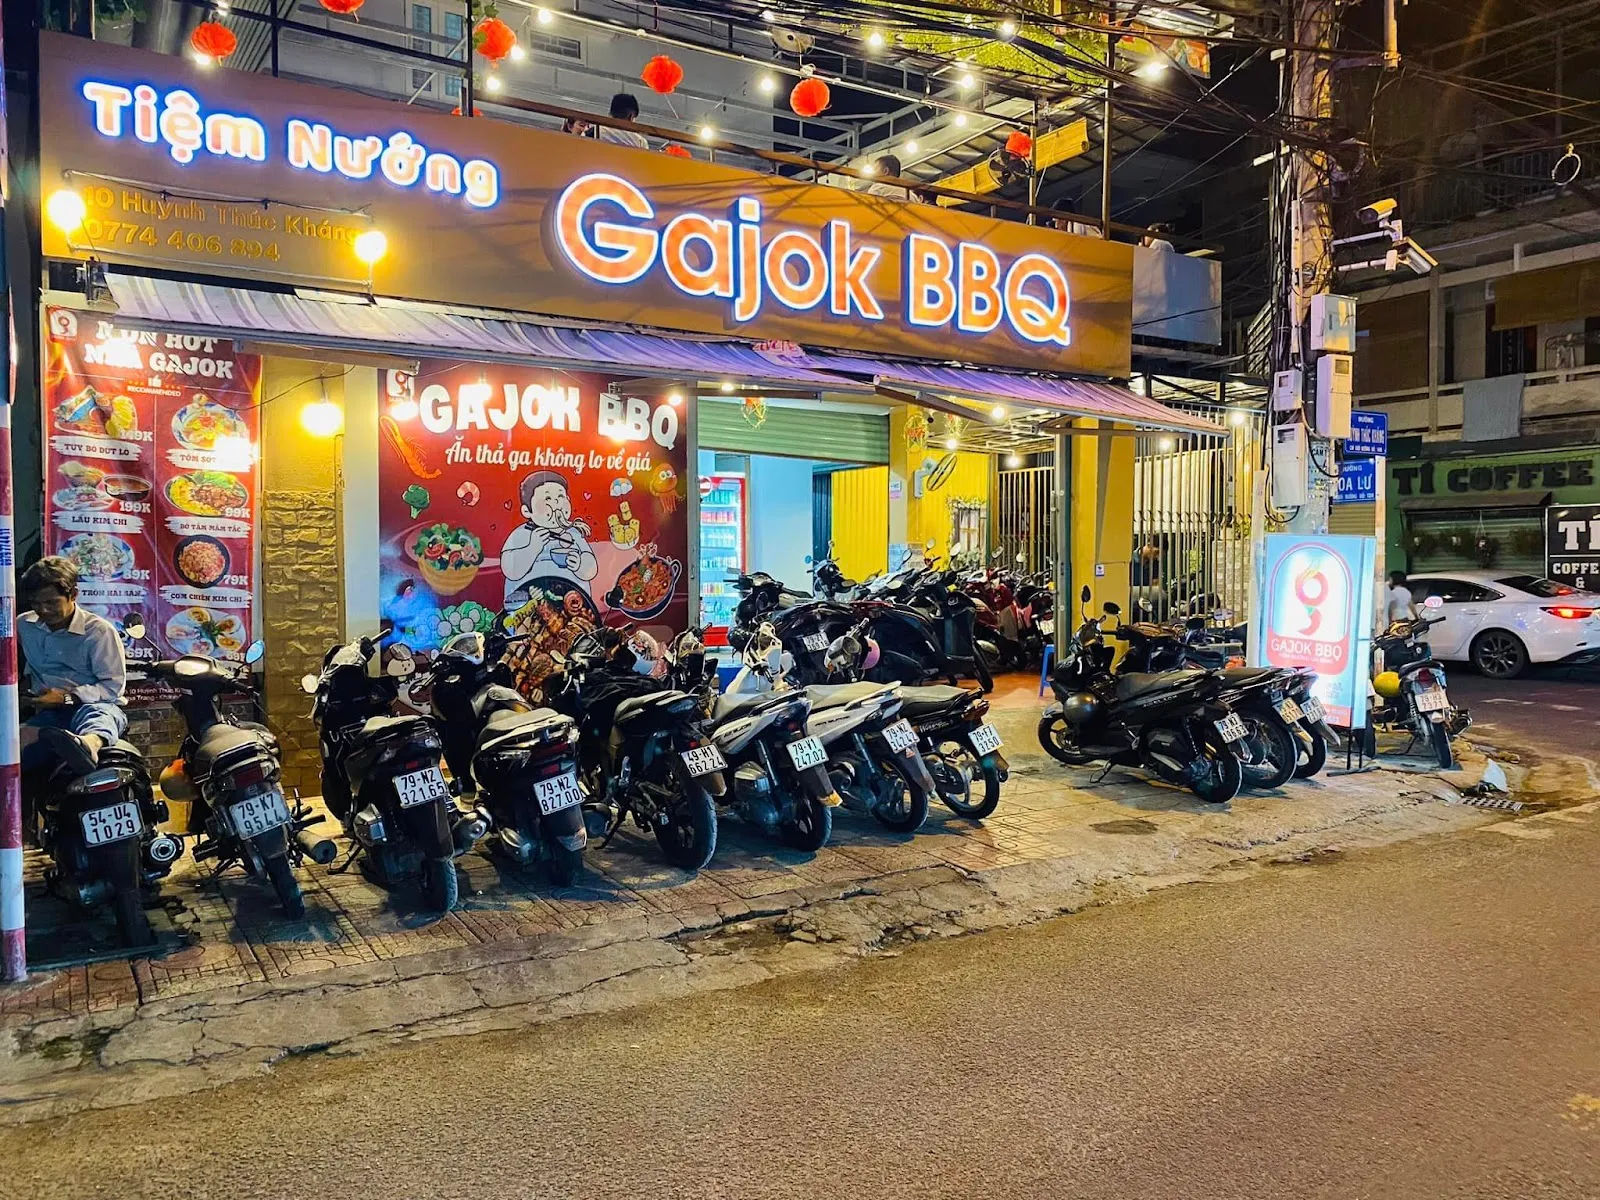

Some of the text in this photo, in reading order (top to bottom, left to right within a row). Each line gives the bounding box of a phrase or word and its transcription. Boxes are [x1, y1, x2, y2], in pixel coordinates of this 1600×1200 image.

[83, 81, 499, 207] Tiệm Nướng
[84, 218, 281, 262] 0774 406 894
[555, 172, 1071, 347] Gajok BBQ
[164, 333, 218, 354] HOT
[149, 351, 233, 379] GAJOK
[418, 383, 679, 450] GAJOK BBQ
[444, 434, 653, 479] Ăn thả ga không lo về giá
[1338, 476, 1353, 491] OA
[1447, 459, 1594, 493] COFFEE
[119, 500, 151, 514] 199K
[92, 517, 111, 526] KIM
[113, 518, 128, 526] CHI
[223, 574, 248, 586] 79K
[1552, 562, 1599, 575] COFFE
[1575, 576, 1585, 589] &
[1271, 638, 1313, 656] GAJOK
[1315, 642, 1343, 662] BBQ
[687, 746, 714, 762] 49-H1
[795, 749, 826, 769] 247.02
[688, 759, 724, 775] 662.24
[400, 768, 437, 791] 79-N2
[539, 776, 571, 798] 79-N2
[401, 781, 445, 806] 321.65
[542, 788, 582, 812] 827.00
[88, 806, 131, 827] 54-U4
[238, 794, 275, 820] 79-K7
[92, 820, 135, 843] 1029
[244, 812, 282, 835] 9544
